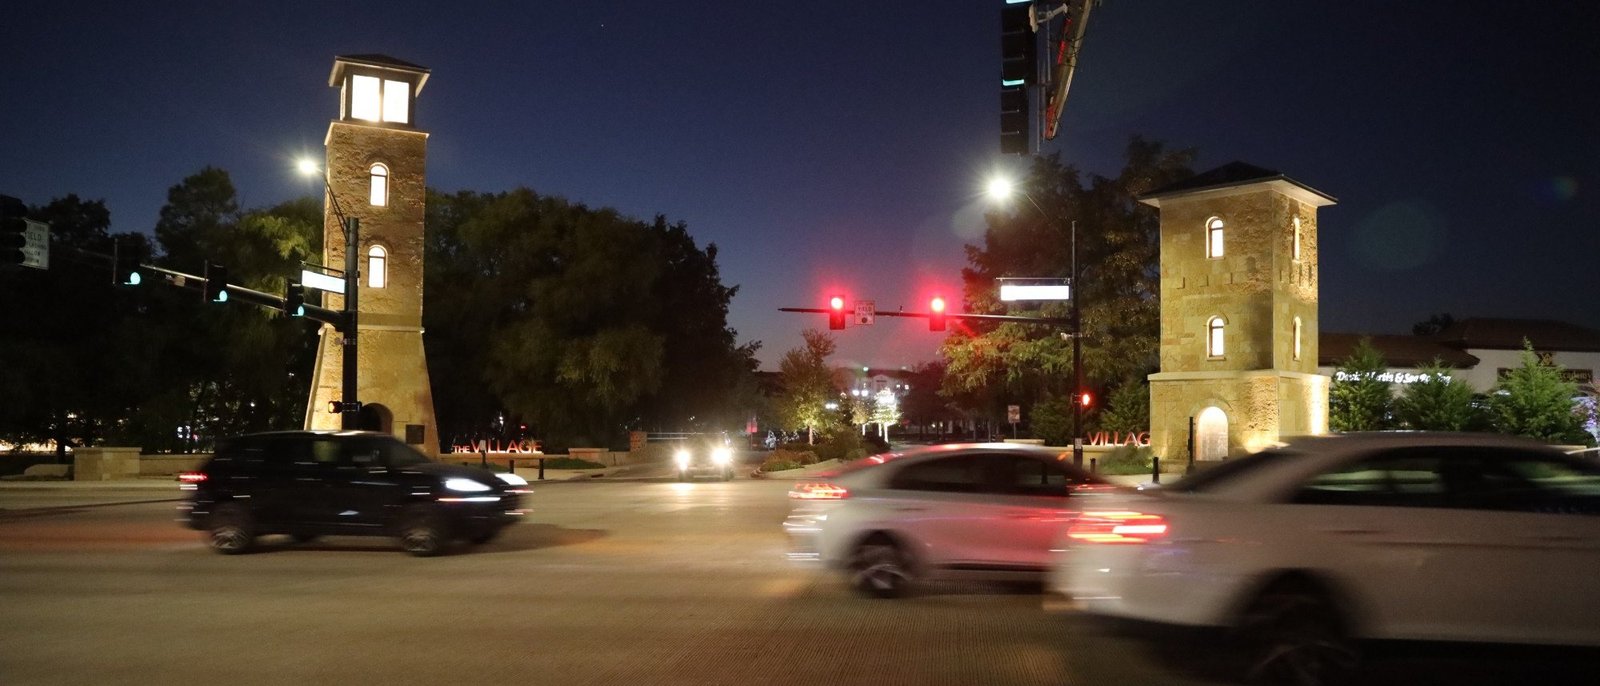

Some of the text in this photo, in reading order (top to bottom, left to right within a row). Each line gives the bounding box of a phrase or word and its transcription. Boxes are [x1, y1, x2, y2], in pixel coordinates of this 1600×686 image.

[452, 439, 543, 453] THE VLLAGE
[1087, 431, 1152, 447] VILLAG
